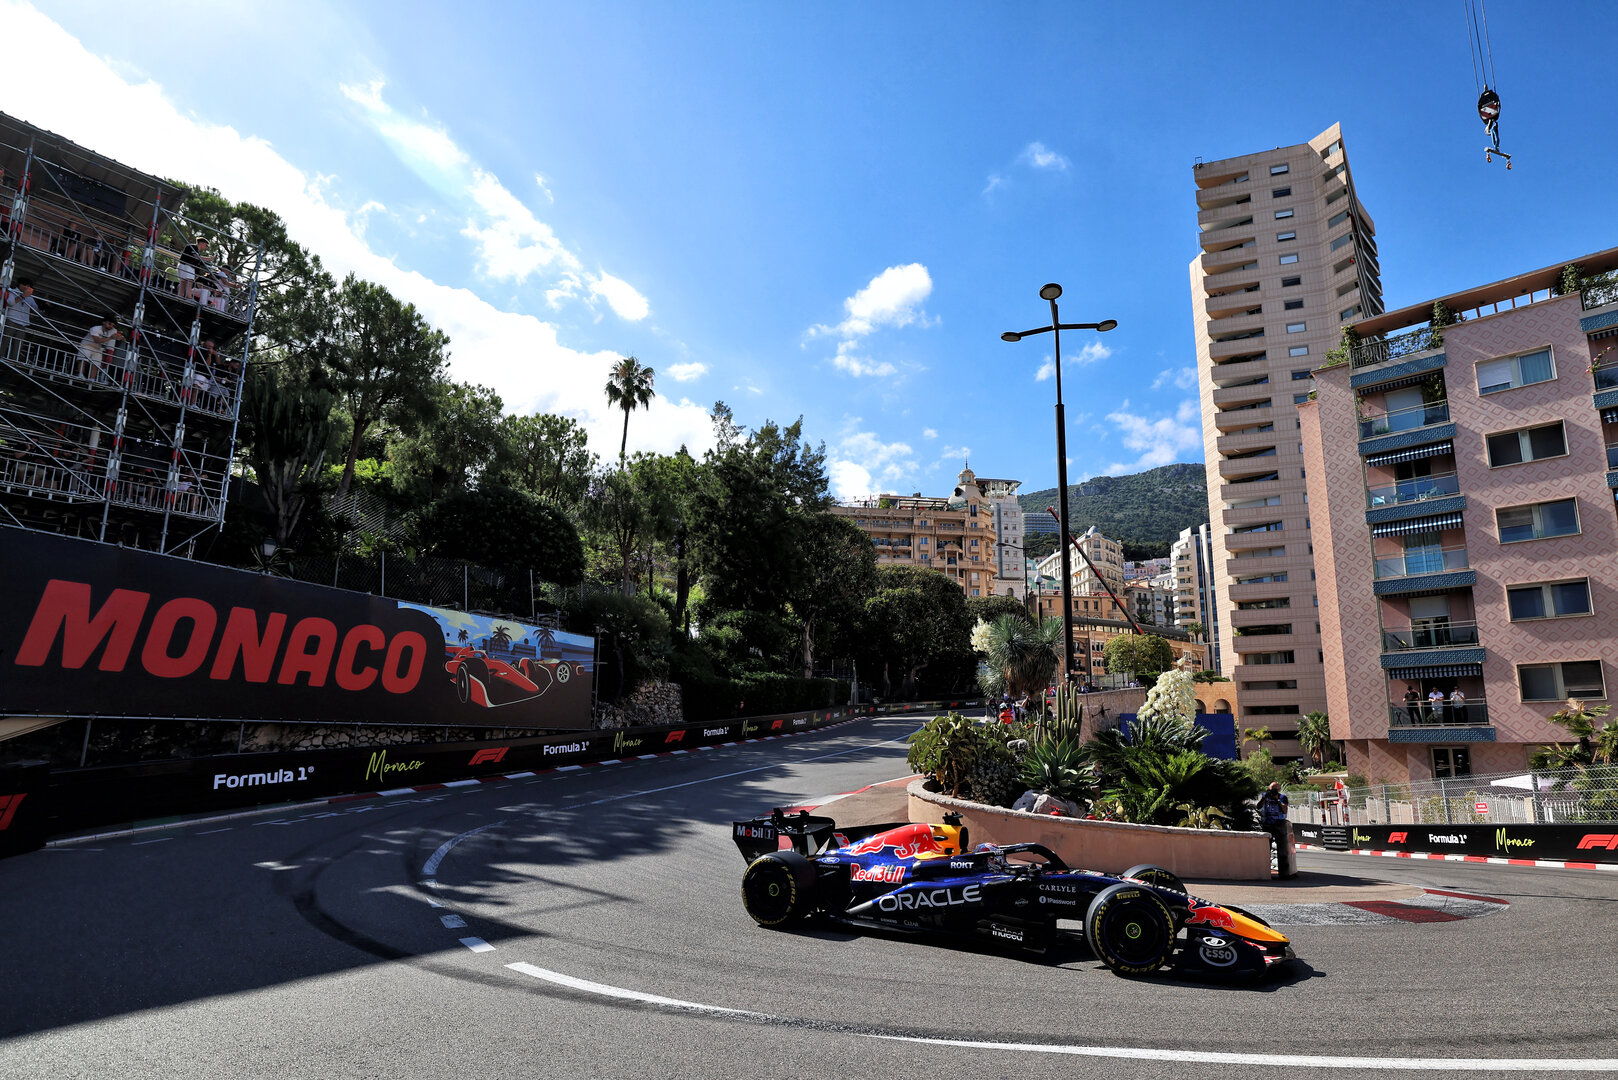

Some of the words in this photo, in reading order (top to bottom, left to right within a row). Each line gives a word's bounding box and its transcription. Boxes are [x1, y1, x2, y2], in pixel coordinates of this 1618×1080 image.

[15, 578, 427, 694] MONACO
[613, 730, 643, 754] Monaco
[703, 728, 724, 737] Formula
[543, 742, 580, 756] Formula
[365, 749, 425, 783] Monaco
[213, 768, 294, 790] Formula
[737, 825, 763, 839] Mobil
[1428, 833, 1459, 844] Formula
[1495, 827, 1535, 854] Monaco
[850, 862, 874, 881] Red
[872, 864, 906, 884] Bull
[950, 861, 974, 869] ROKT
[879, 884, 982, 912] ORACLE
[1039, 884, 1076, 893] CARLYLE
